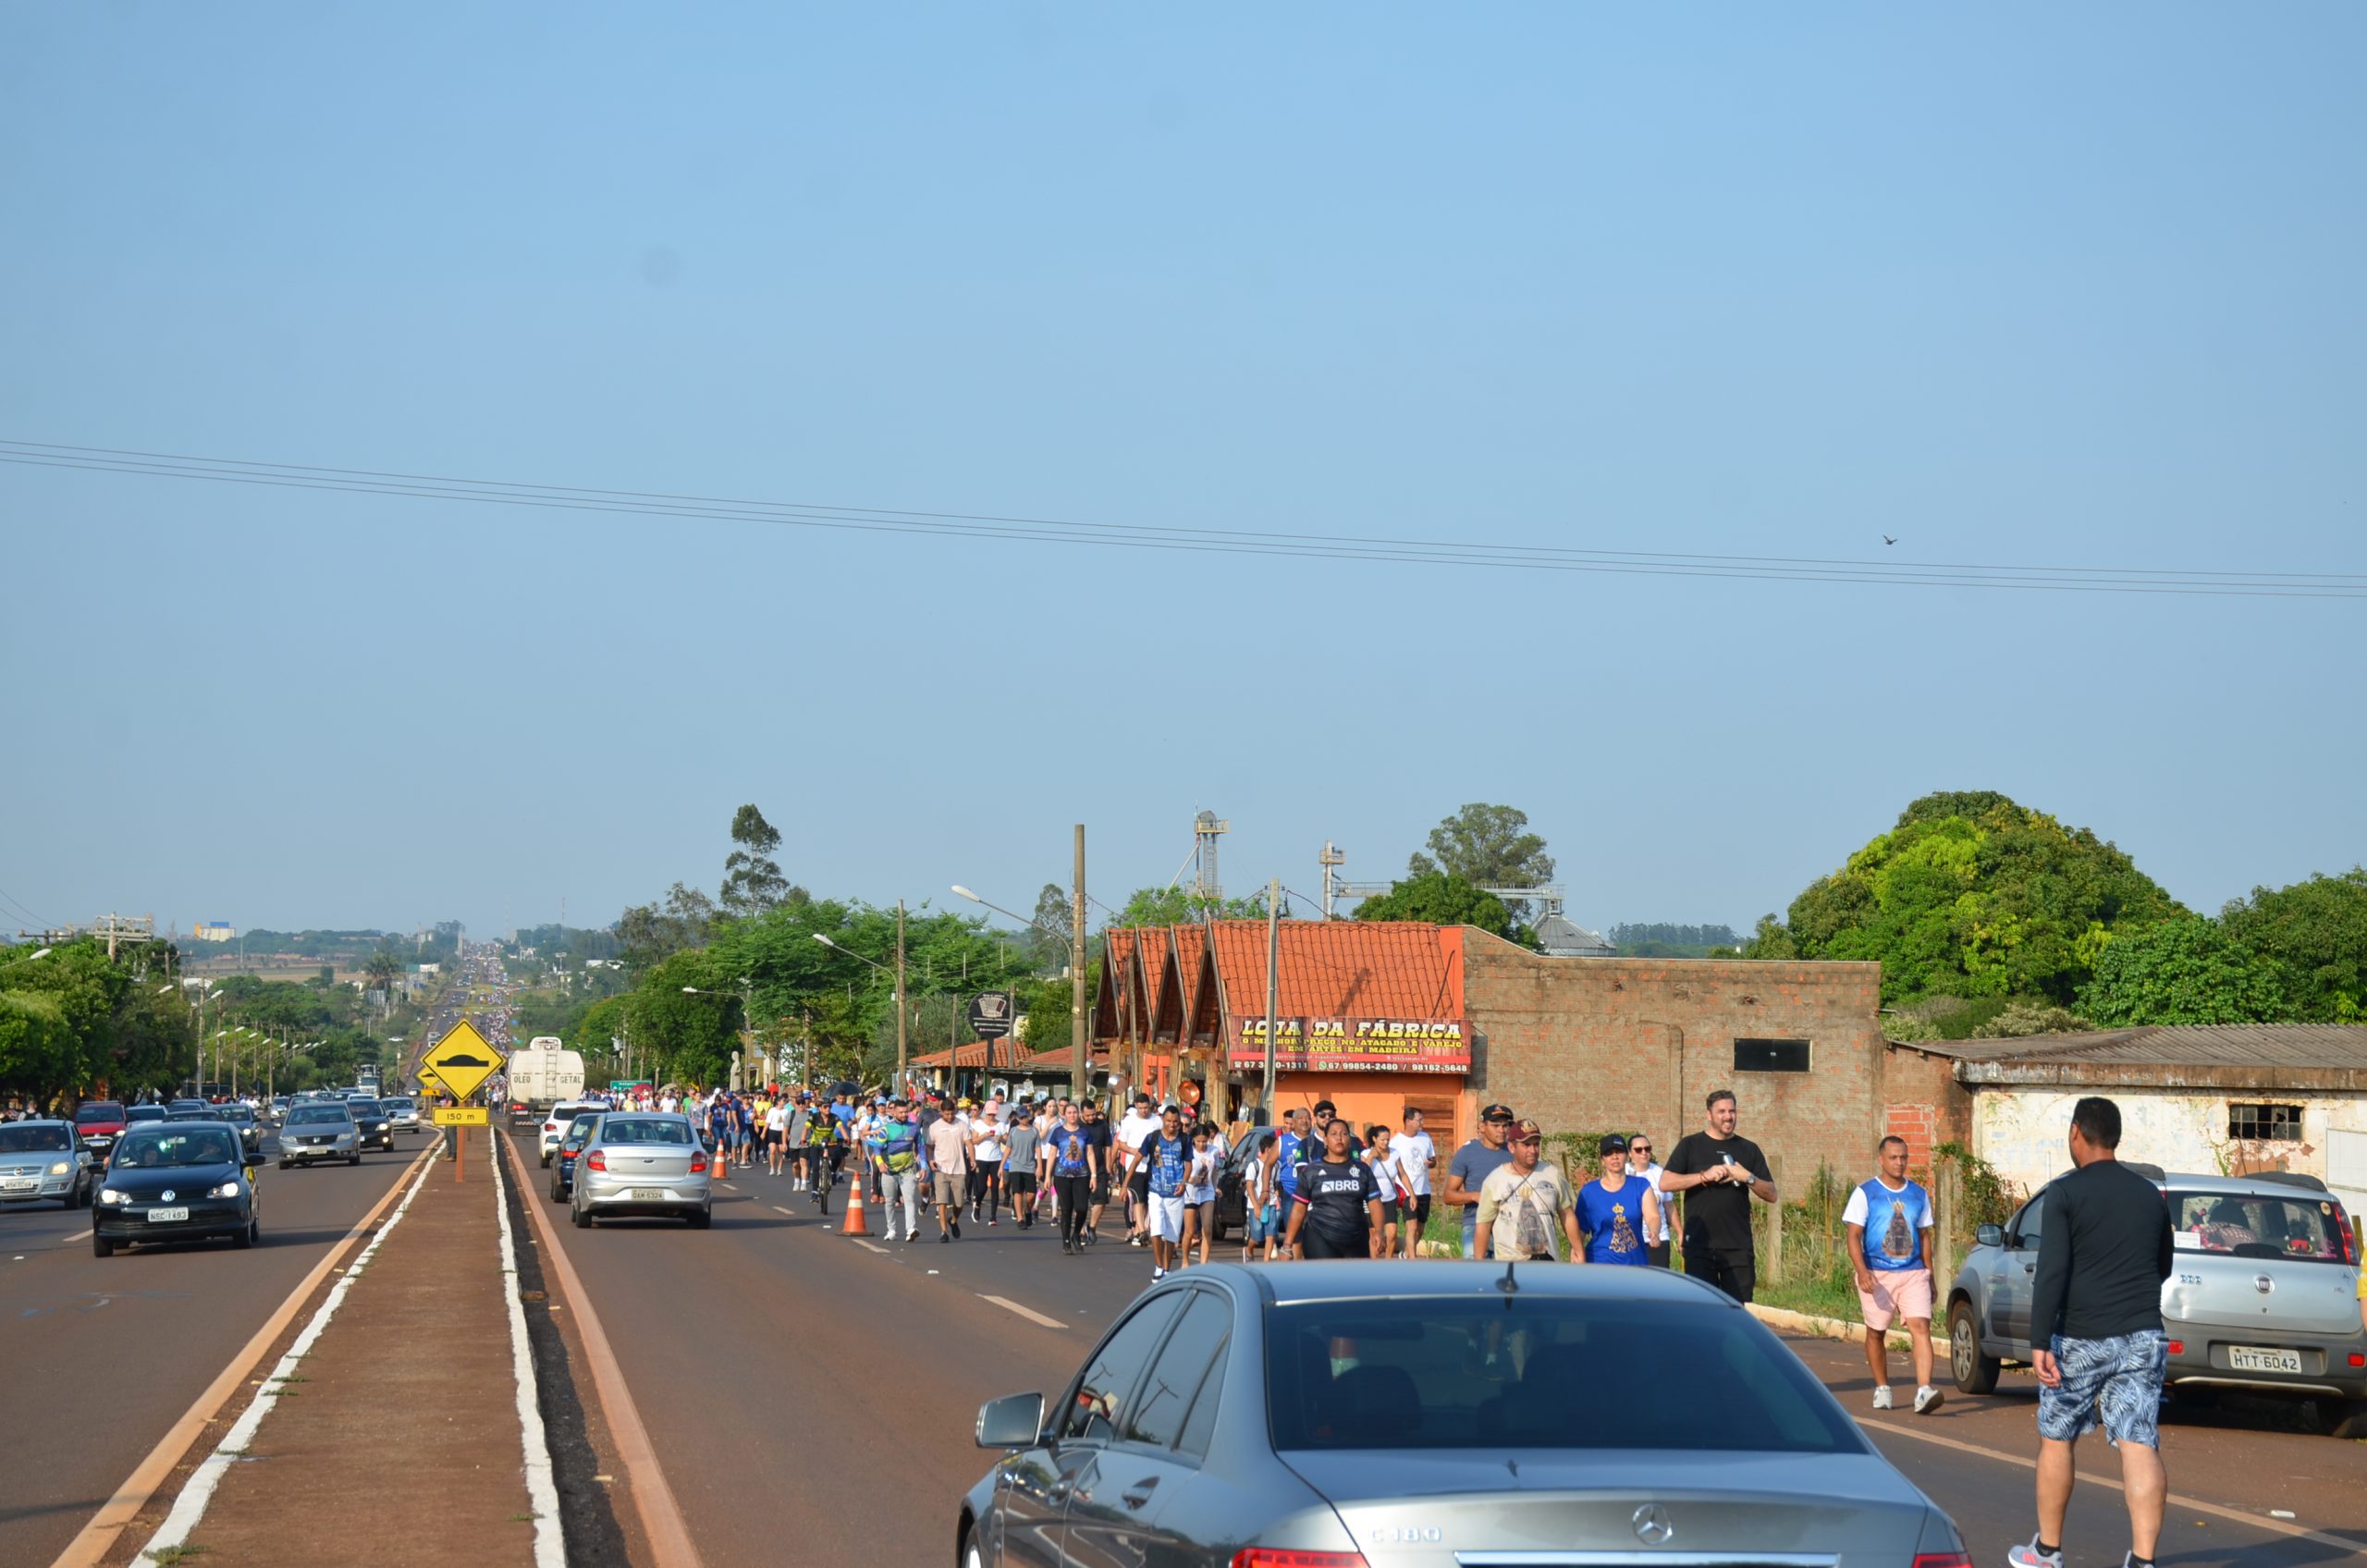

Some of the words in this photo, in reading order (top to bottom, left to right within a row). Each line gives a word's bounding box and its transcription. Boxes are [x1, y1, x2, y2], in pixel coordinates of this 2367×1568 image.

[1242, 1020, 1302, 1036] LOJA
[1313, 1022, 1345, 1036] DA
[1355, 1019, 1462, 1039] FÁBRICA
[1304, 1038, 1336, 1047] PREÇO
[1343, 1062, 1398, 1071] 99854-2480
[513, 1075, 531, 1084] OLEO
[1335, 1180, 1360, 1192] BRB
